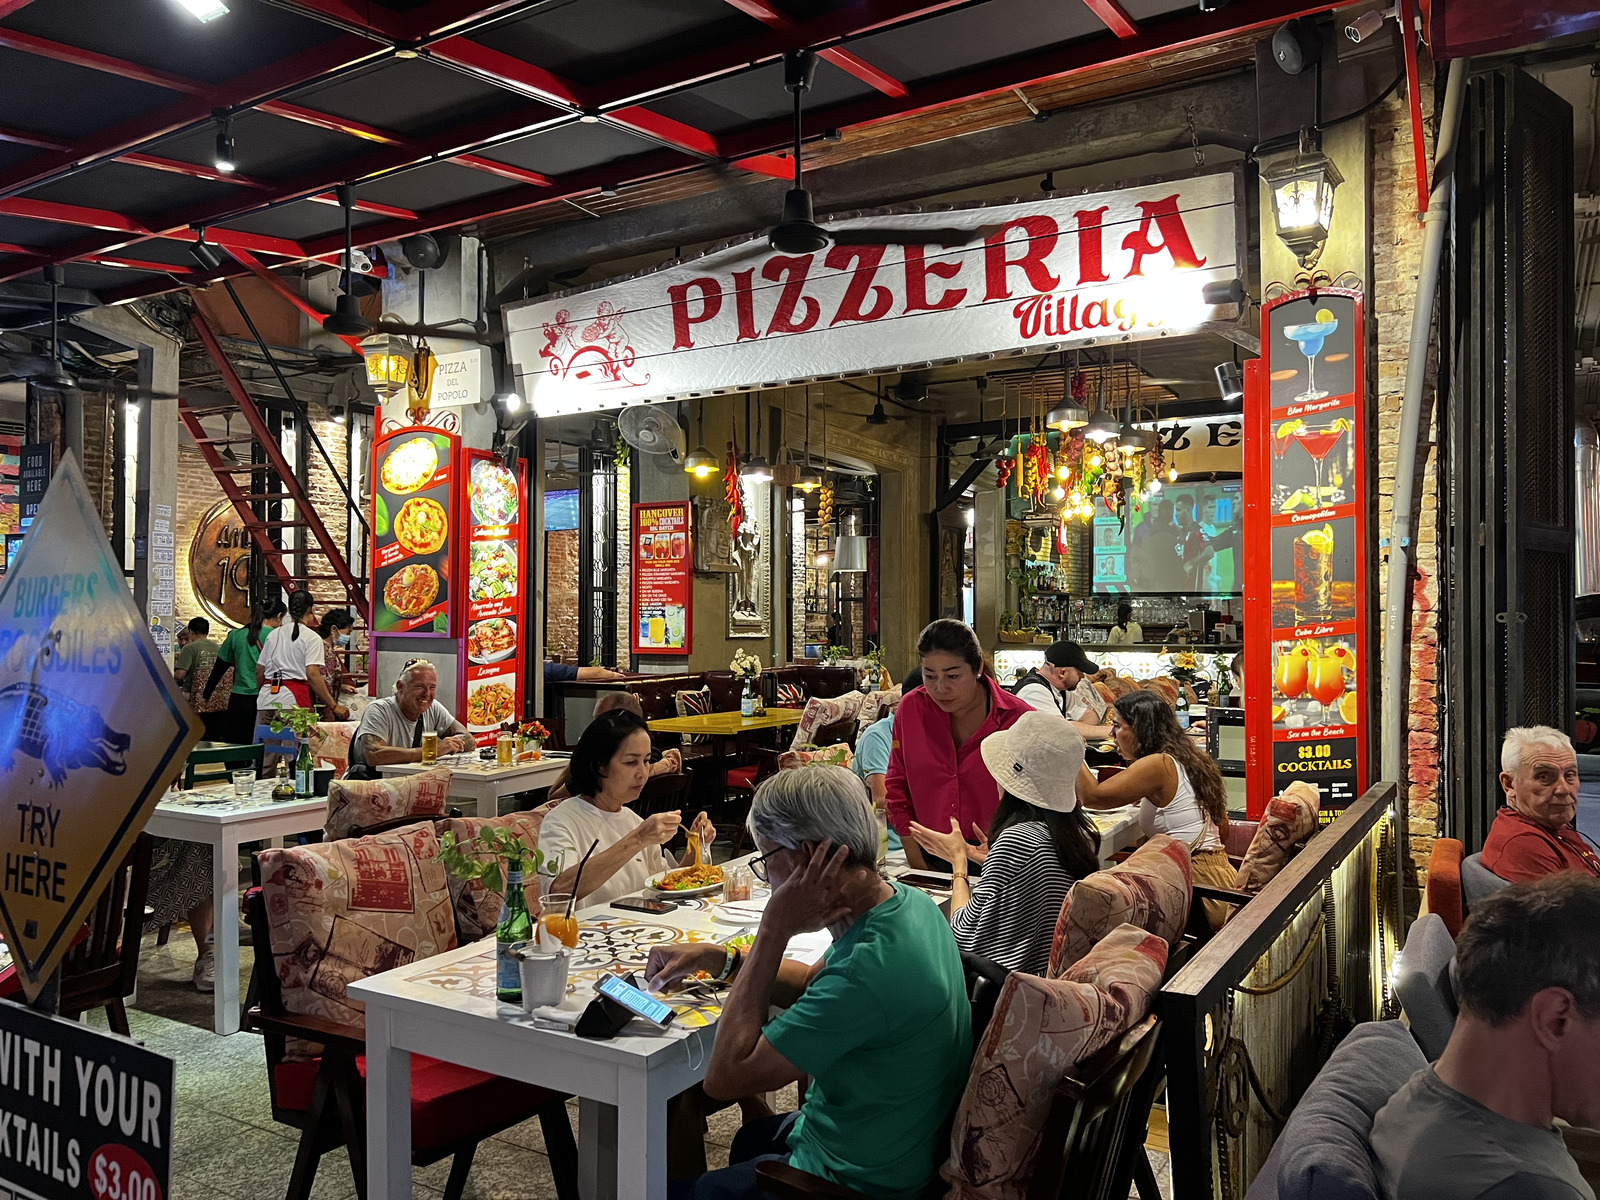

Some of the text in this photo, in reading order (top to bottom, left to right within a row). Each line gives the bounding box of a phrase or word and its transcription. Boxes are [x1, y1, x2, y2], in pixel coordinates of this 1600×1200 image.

[667, 193, 1207, 351] PIZZERIA
[438, 362, 467, 376] PIZZA
[446, 378, 459, 386] DEL
[438, 389, 468, 401] POPOLO
[1287, 398, 1340, 416] Blue Margarita
[27, 456, 42, 468] FOOD
[26, 479, 42, 492] HERE
[640, 508, 684, 518] HANGOVER
[1291, 509, 1336, 523] Cosmopolitan
[640, 517, 658, 527] 100%
[14, 572, 99, 618] BURGERS
[1295, 626, 1334, 636] Cuba Libre
[1286, 730, 1300, 739] Sex
[1323, 728, 1344, 736] Beach
[1298, 744, 1331, 759] $3.00
[1278, 759, 1352, 772] COCKTAILS
[17, 804, 61, 848] TRY
[5, 852, 67, 904] HERE
[75, 1055, 161, 1149] YOUR
[94, 1152, 156, 1200] $3.00
